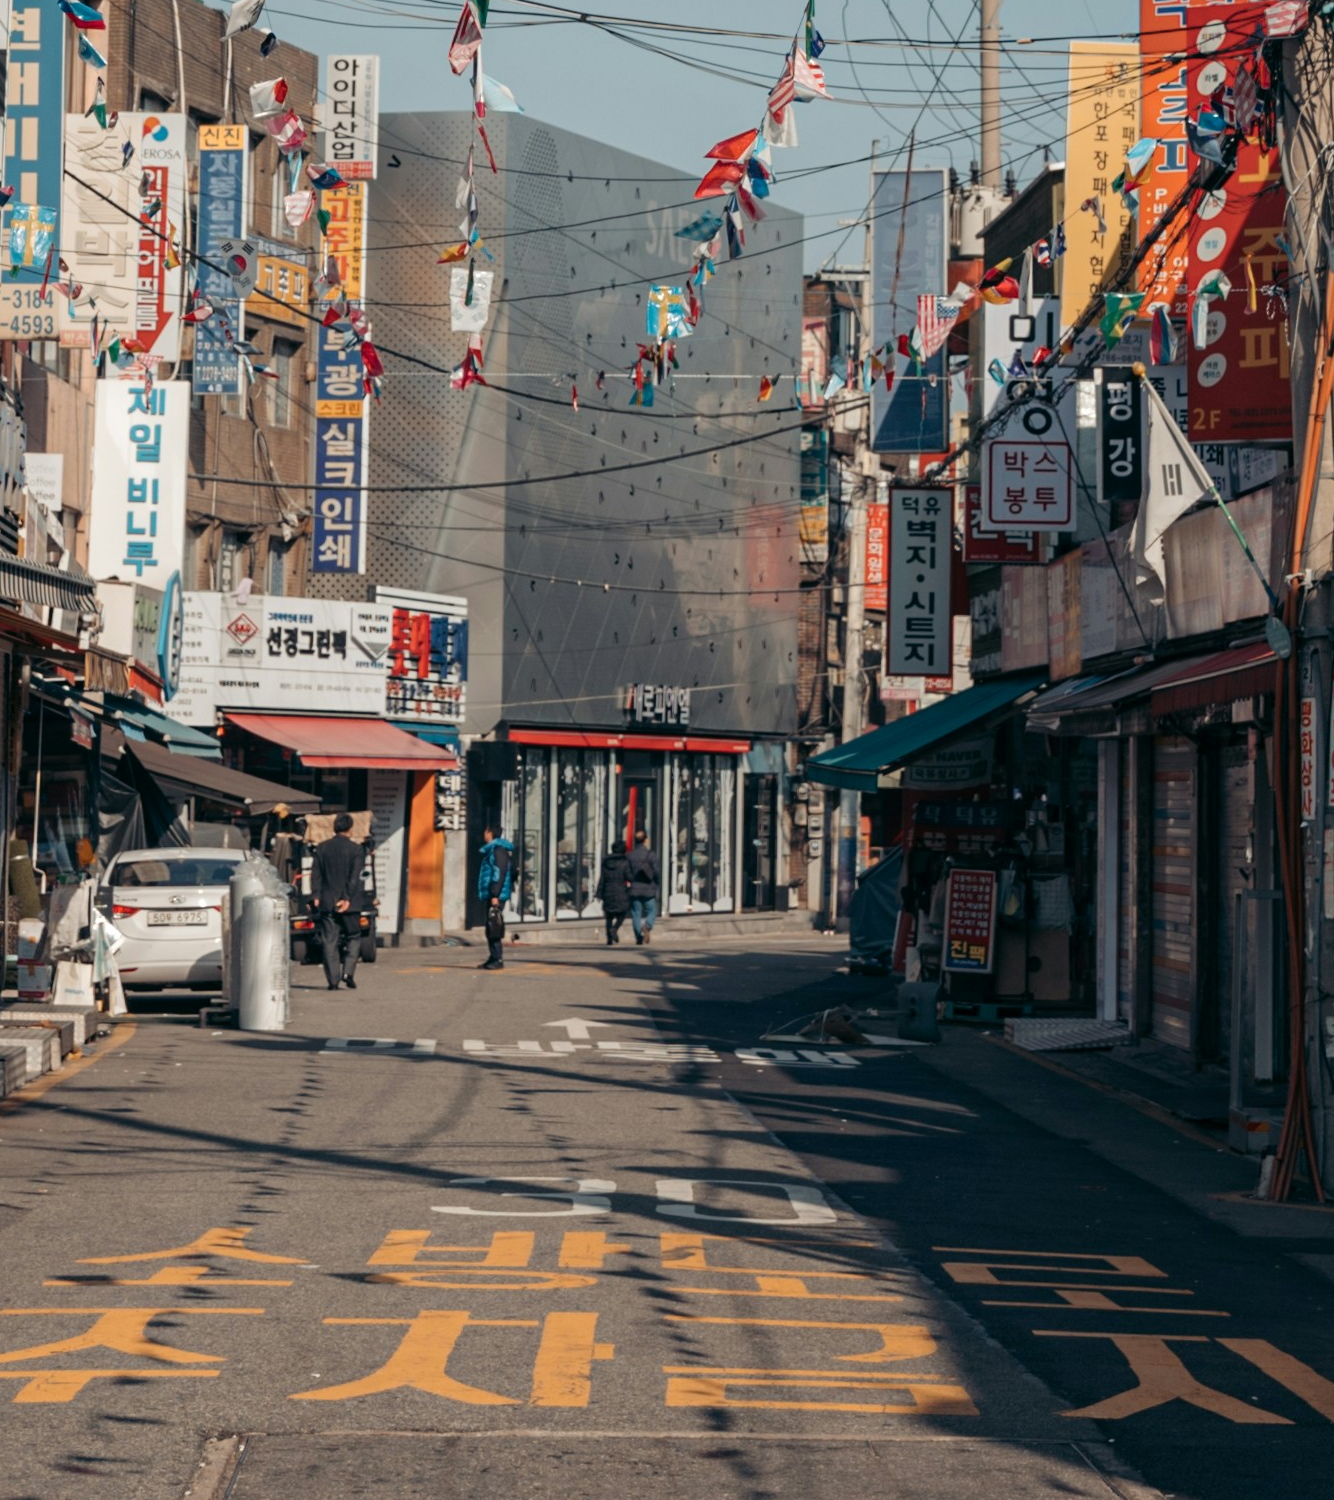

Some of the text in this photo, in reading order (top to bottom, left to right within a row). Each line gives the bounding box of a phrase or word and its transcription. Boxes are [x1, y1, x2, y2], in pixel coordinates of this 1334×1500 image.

[332, 58, 360, 160] 아이디산업
[203, 127, 240, 147] 신진
[319, 402, 361, 416] 스크린
[1107, 382, 1136, 477] 평강
[123, 387, 166, 577] 제일 비니루
[1004, 451, 1058, 478] 박스
[318, 422, 357, 569] 실크인쇄
[902, 497, 941, 516] 덕유
[1003, 487, 1058, 514] 봉투
[430, 1177, 836, 1224] 30
